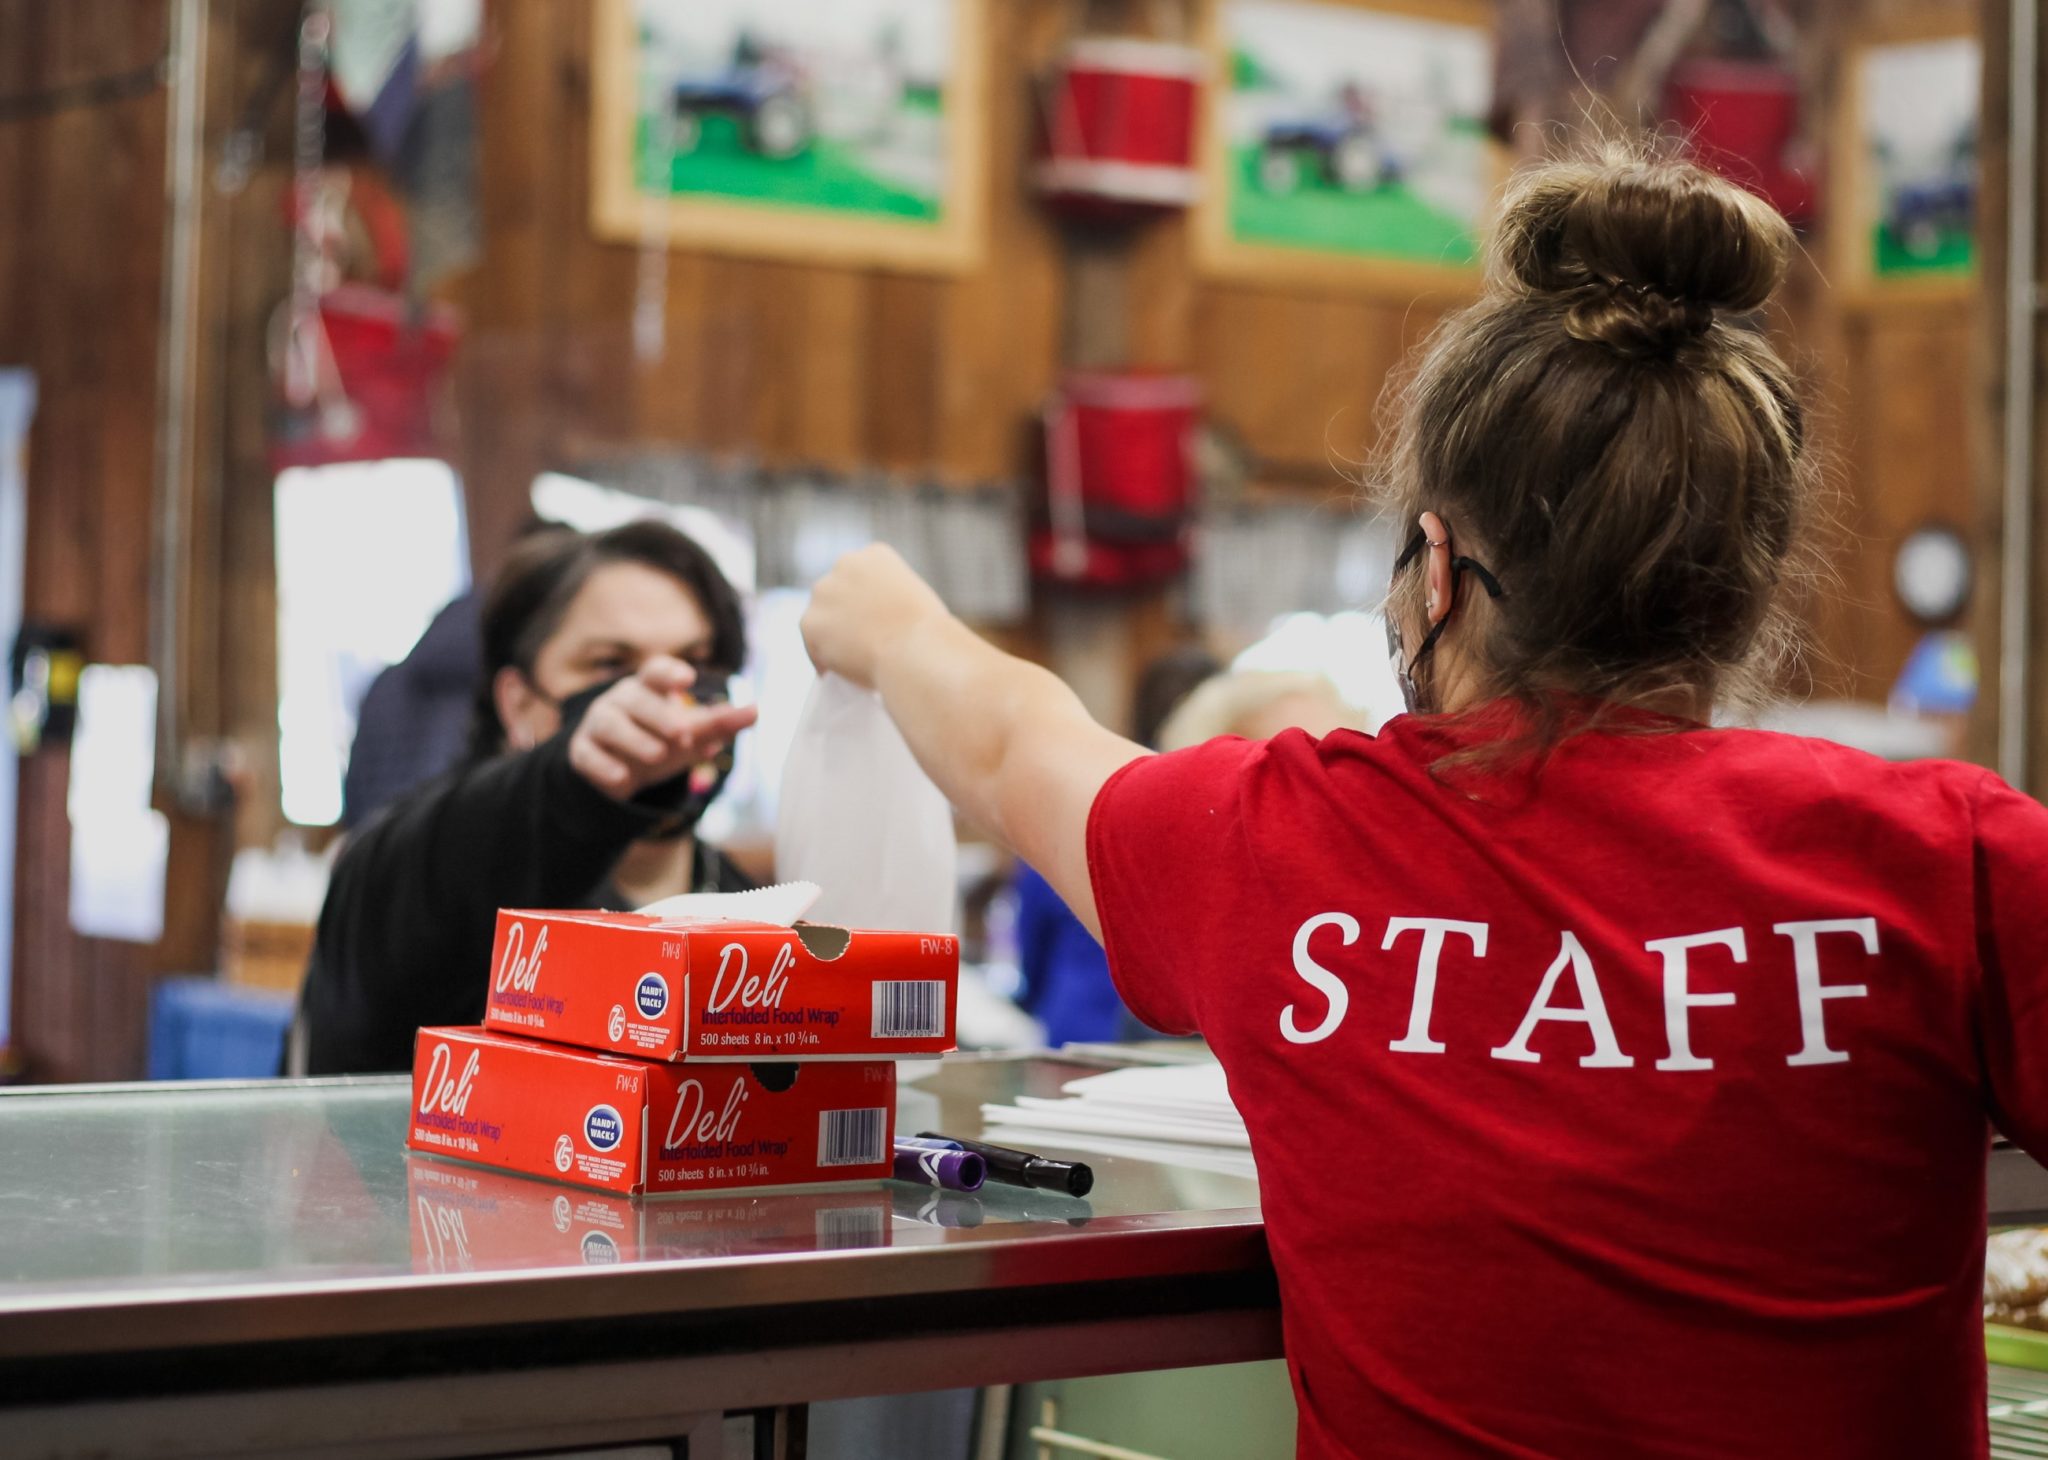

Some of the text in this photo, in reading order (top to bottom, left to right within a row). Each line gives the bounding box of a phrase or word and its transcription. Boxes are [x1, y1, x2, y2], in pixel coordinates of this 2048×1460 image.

[662, 942, 681, 960] FW-8
[920, 939, 953, 956] FW-8
[496, 922, 548, 993] Deli
[707, 942, 796, 1014] Deli
[641, 985, 663, 997] HANDY
[1279, 912, 1881, 1071] STAFF
[640, 996, 662, 1008] WACKS
[702, 1008, 839, 1028] Interfolded Food Wrap
[700, 1033, 719, 1045] 500
[721, 1032, 750, 1045] sheets
[754, 1032, 761, 1045] 8
[763, 1032, 774, 1045] in.
[776, 1034, 781, 1044] x
[785, 1032, 795, 1044] 10
[809, 1032, 820, 1044] in.
[419, 1043, 480, 1116] Deli
[616, 1074, 638, 1093] FW-8
[591, 1116, 616, 1130] HANDY
[665, 1077, 749, 1150] Deli
[460, 1115, 479, 1135] Food
[481, 1120, 501, 1143] Wrap
[590, 1128, 615, 1141] WACKS
[660, 1140, 788, 1160] Interfolded Food Wrap
[659, 1169, 675, 1181] 500
[677, 1168, 704, 1180] sheets
[708, 1166, 714, 1179] 8
[716, 1166, 726, 1178] in.
[728, 1168, 734, 1177] x
[736, 1165, 747, 1177] 10
